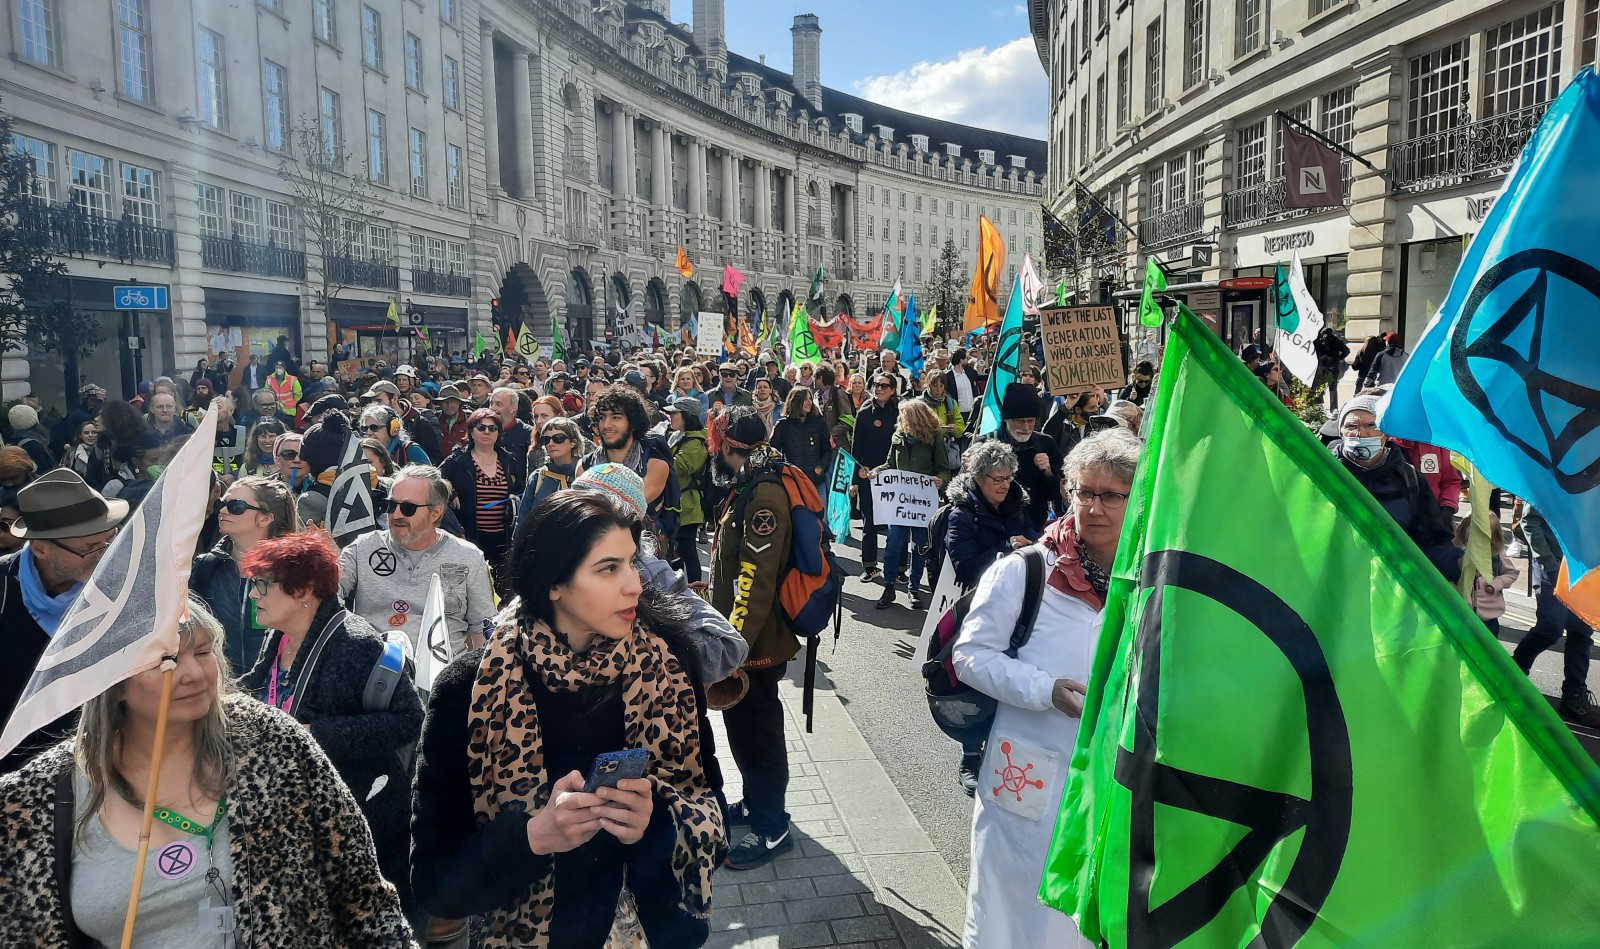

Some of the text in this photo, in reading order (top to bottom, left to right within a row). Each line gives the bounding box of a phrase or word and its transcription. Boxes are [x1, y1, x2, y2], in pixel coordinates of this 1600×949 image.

[1263, 230, 1315, 256] NESPRESSO
[1074, 309, 1091, 323] THE
[1093, 308, 1112, 322] LAST
[1046, 326, 1111, 345] GENERATION
[1050, 343, 1116, 361] WHO CAN SAVE
[1050, 359, 1119, 387] SOMETHING
[874, 472, 934, 489] I am here for
[896, 506, 926, 521] Future
[729, 561, 758, 634] KRUST
